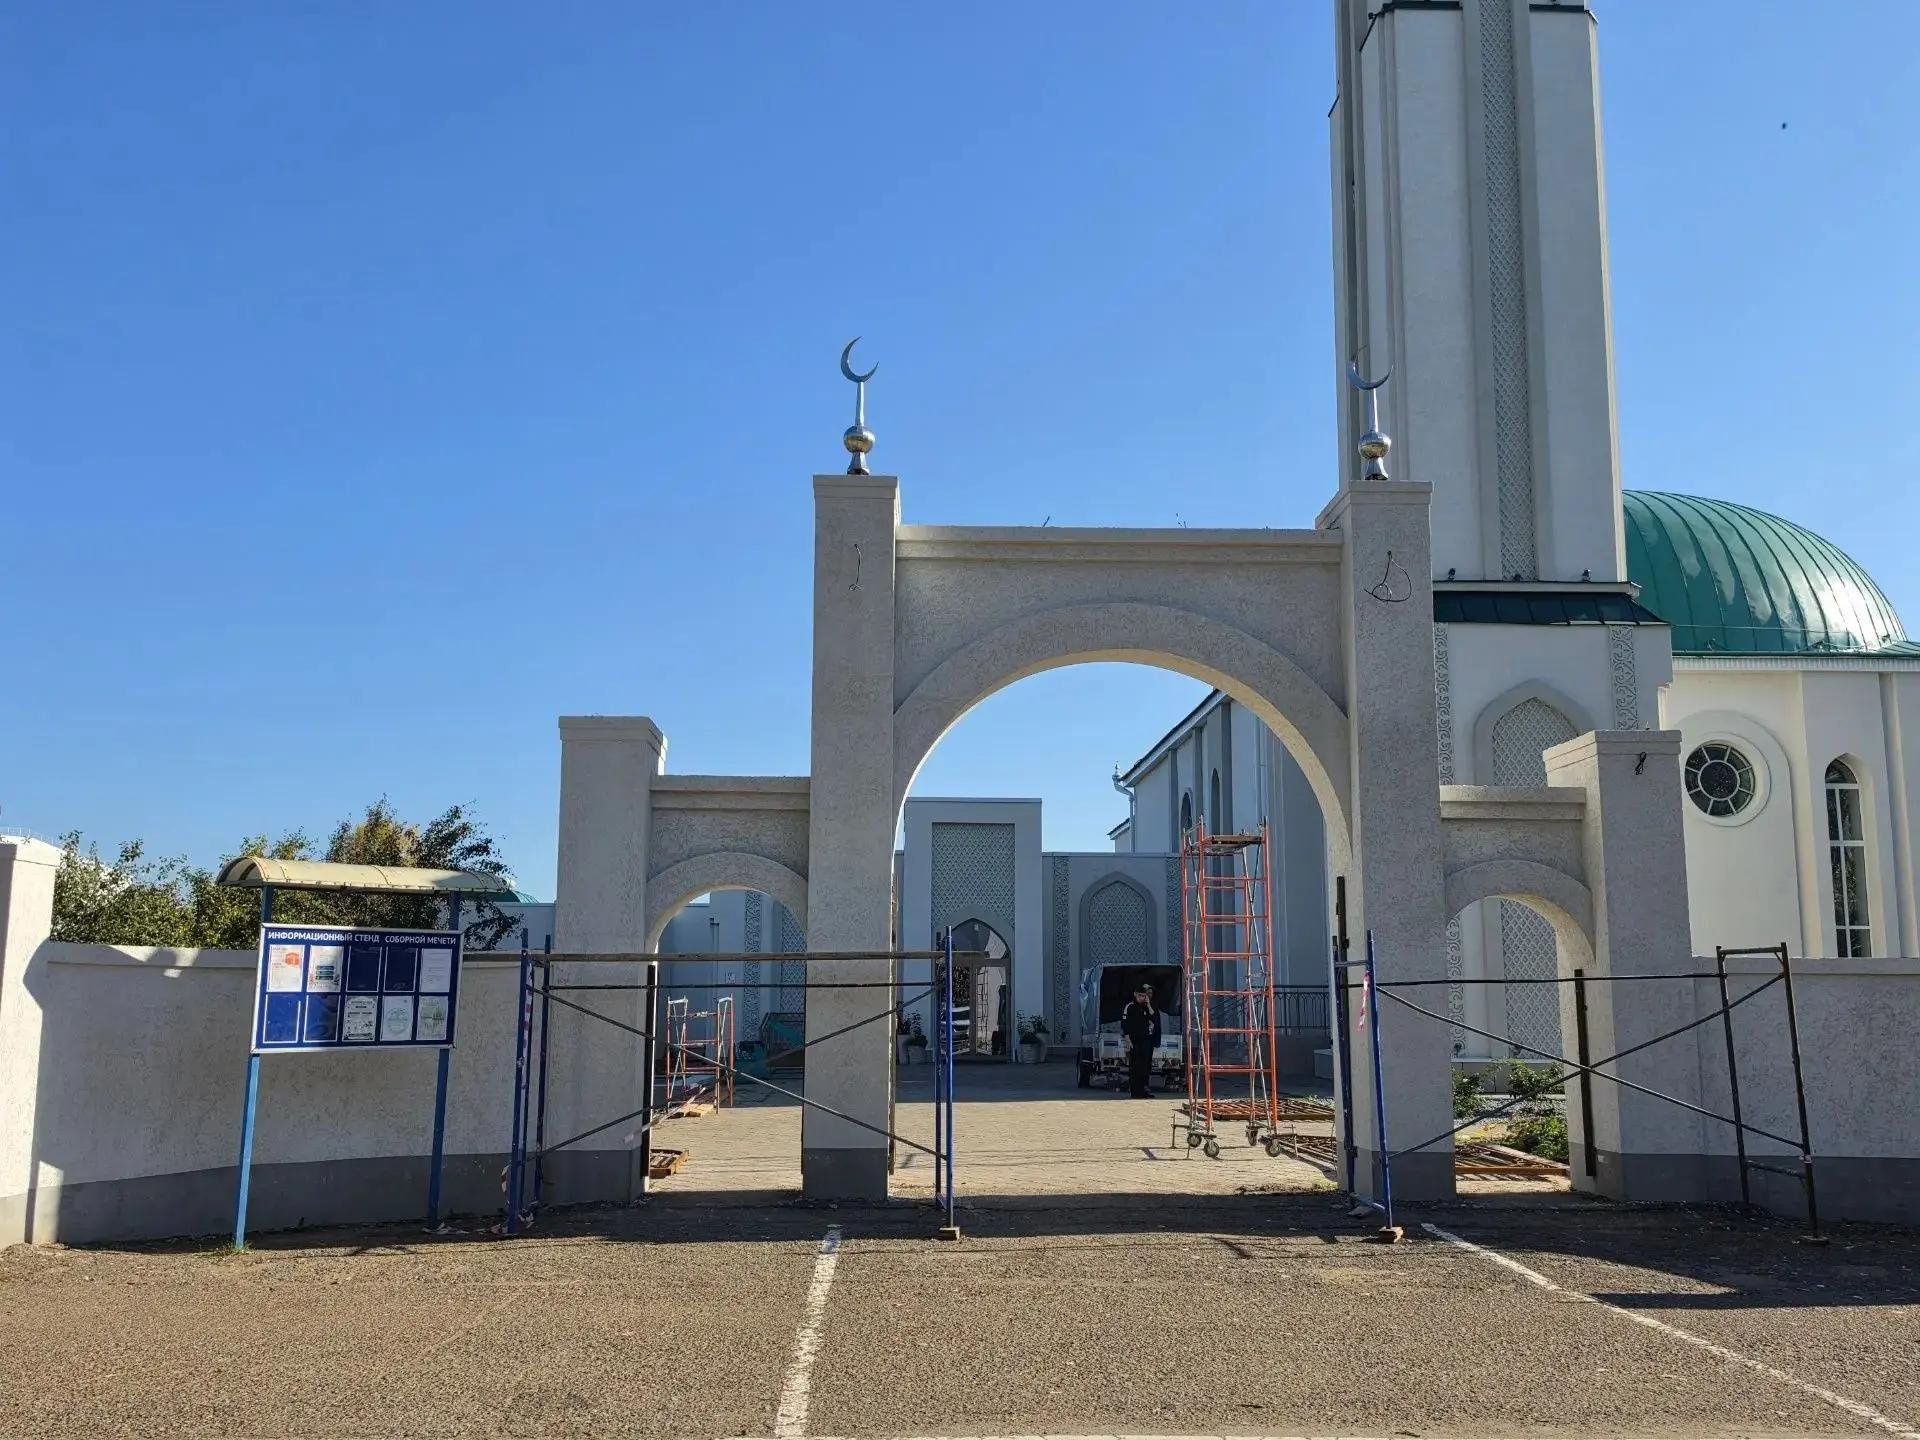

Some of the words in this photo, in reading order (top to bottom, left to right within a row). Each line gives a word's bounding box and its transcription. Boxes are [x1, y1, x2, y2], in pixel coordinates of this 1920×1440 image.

[268, 931, 353, 942] ИНФОРМАЦИОННЫЙ
[354, 934, 380, 943] СТЕНД
[385, 935, 425, 944] СОБОРНОЙ
[427, 936, 456, 945] МЕЧЕТИ
